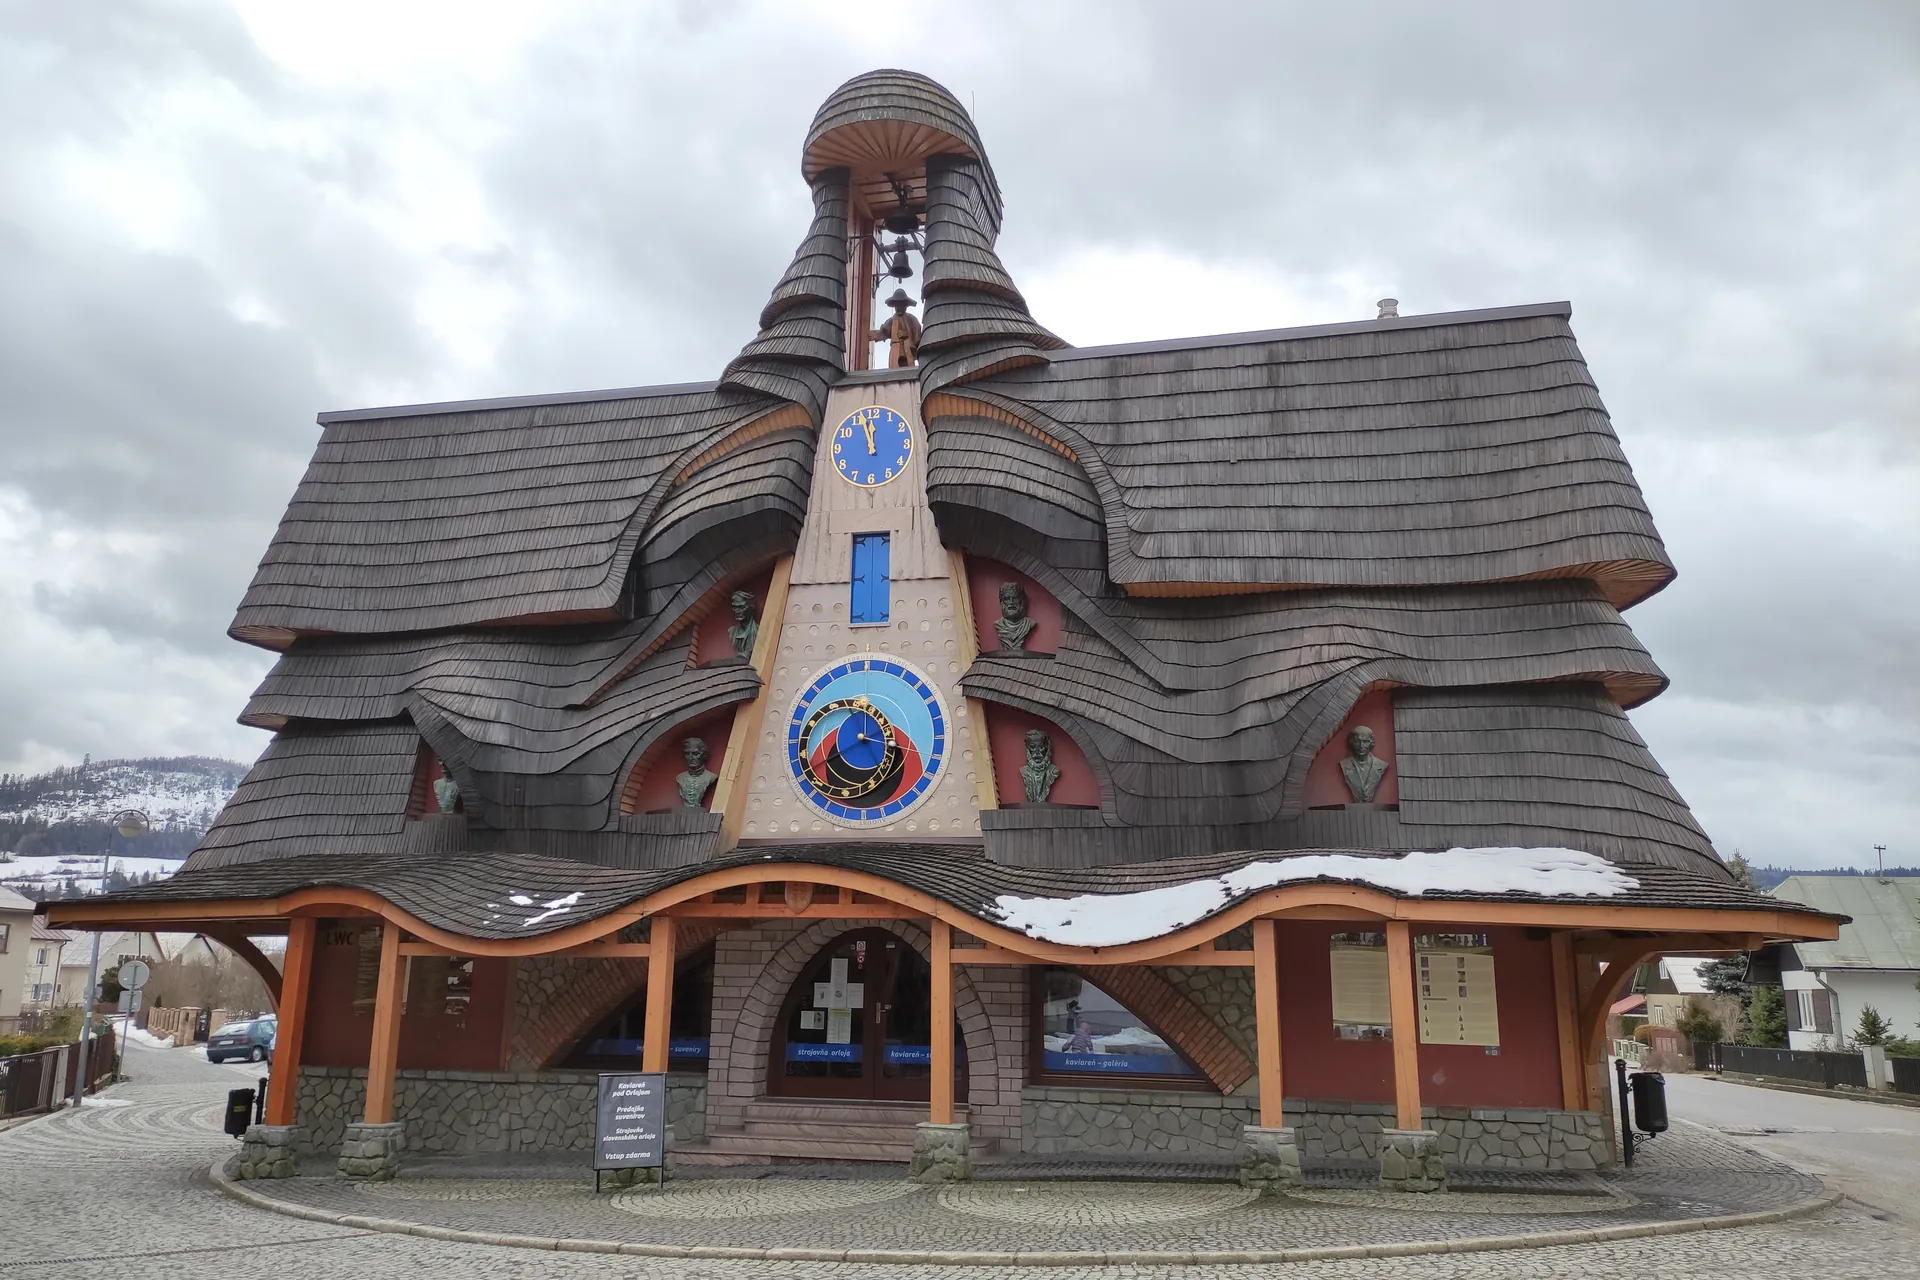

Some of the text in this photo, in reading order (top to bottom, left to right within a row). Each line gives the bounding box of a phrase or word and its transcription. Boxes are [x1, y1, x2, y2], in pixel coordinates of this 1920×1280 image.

[867, 409, 880, 418] 12
[887, 412, 892, 421] 1
[898, 422, 905, 432] 2
[840, 428, 852, 438] 10
[834, 444, 841, 454] 9
[904, 439, 910, 449] 3
[839, 459, 846, 469] 8
[897, 456, 903, 465] 4
[852, 471, 858, 481] 7
[885, 468, 892, 478] 5
[868, 474, 874, 484] 6
[798, 1048, 850, 1057] strojovňa orloja
[890, 1050, 920, 1058] kaviareň
[1065, 1058, 1096, 1066] kaviareň
[1102, 1059, 1128, 1068] galéria
